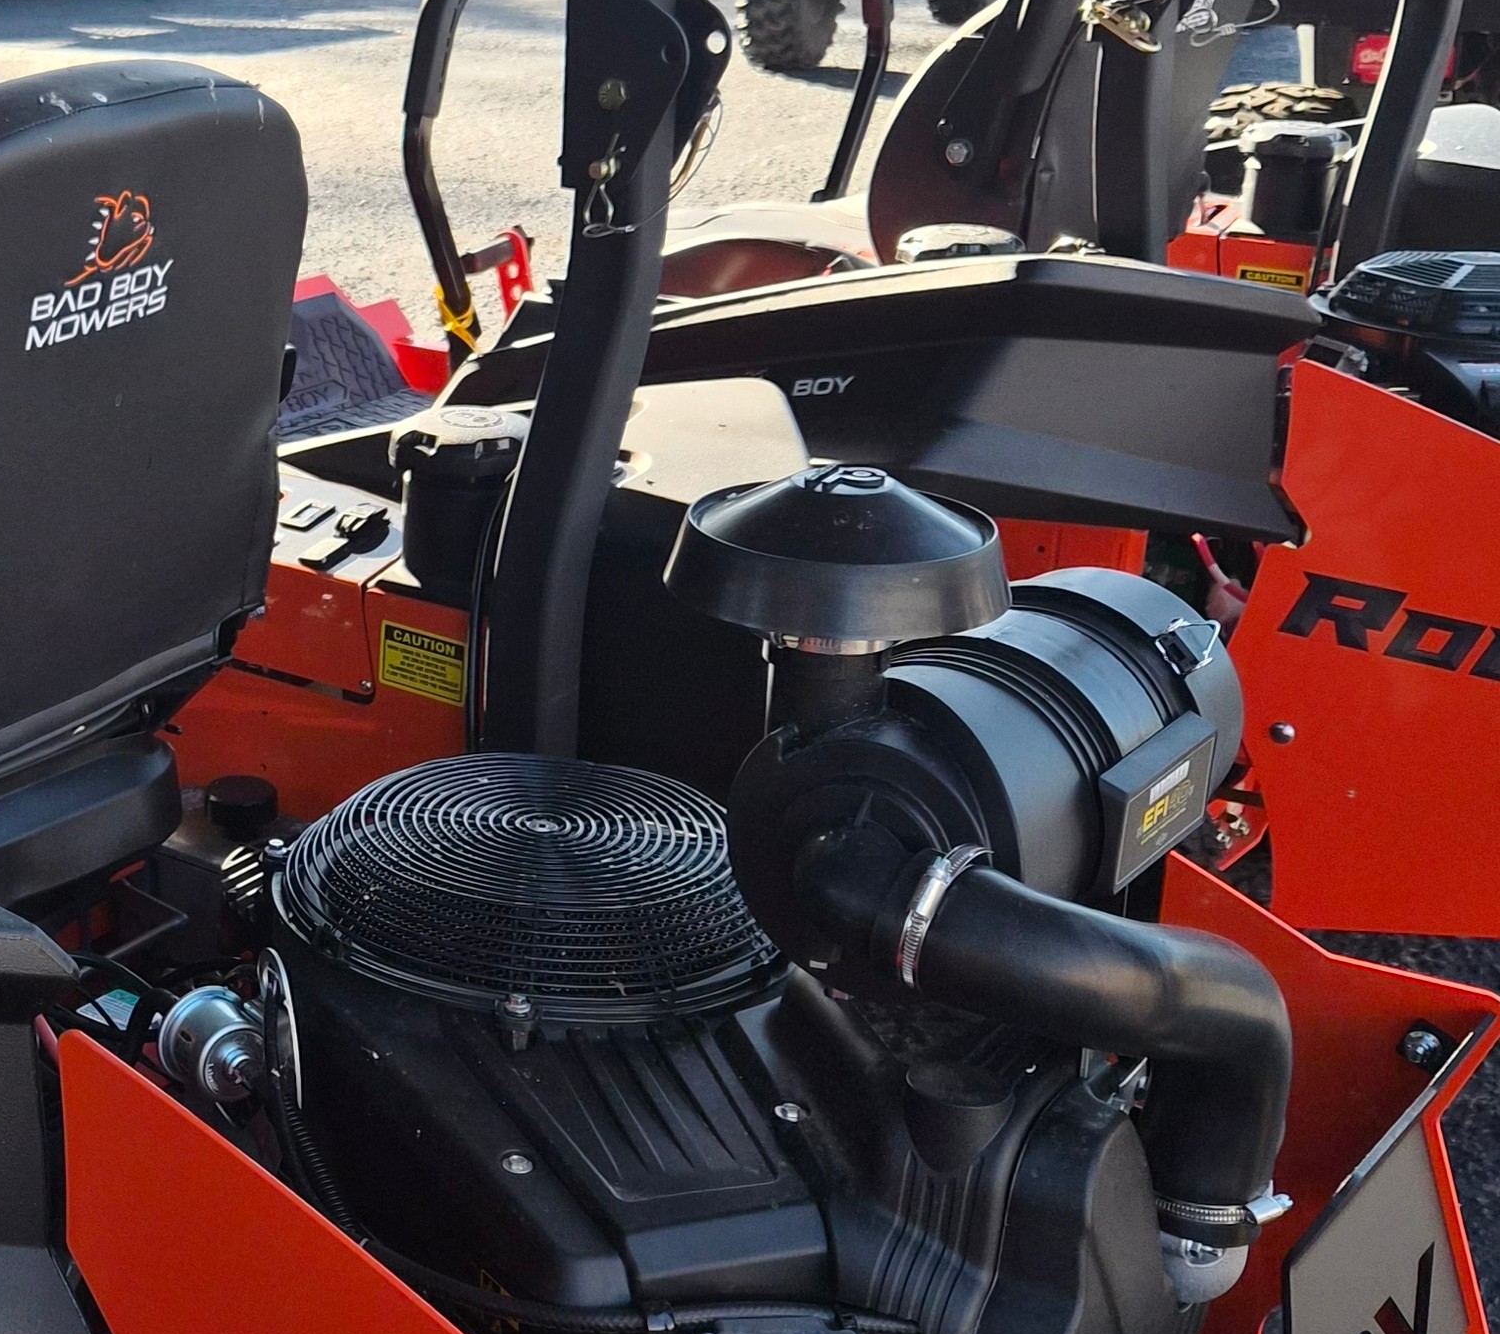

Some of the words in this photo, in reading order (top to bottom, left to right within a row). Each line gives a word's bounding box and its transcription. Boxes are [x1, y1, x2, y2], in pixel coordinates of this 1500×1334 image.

[30, 281, 103, 322] BAD
[109, 259, 175, 302] BOY
[25, 285, 168, 351] MOWERS
[792, 375, 856, 397] BOY
[392, 629, 456, 657] CAUTION
[1142, 794, 1170, 833] EFI
